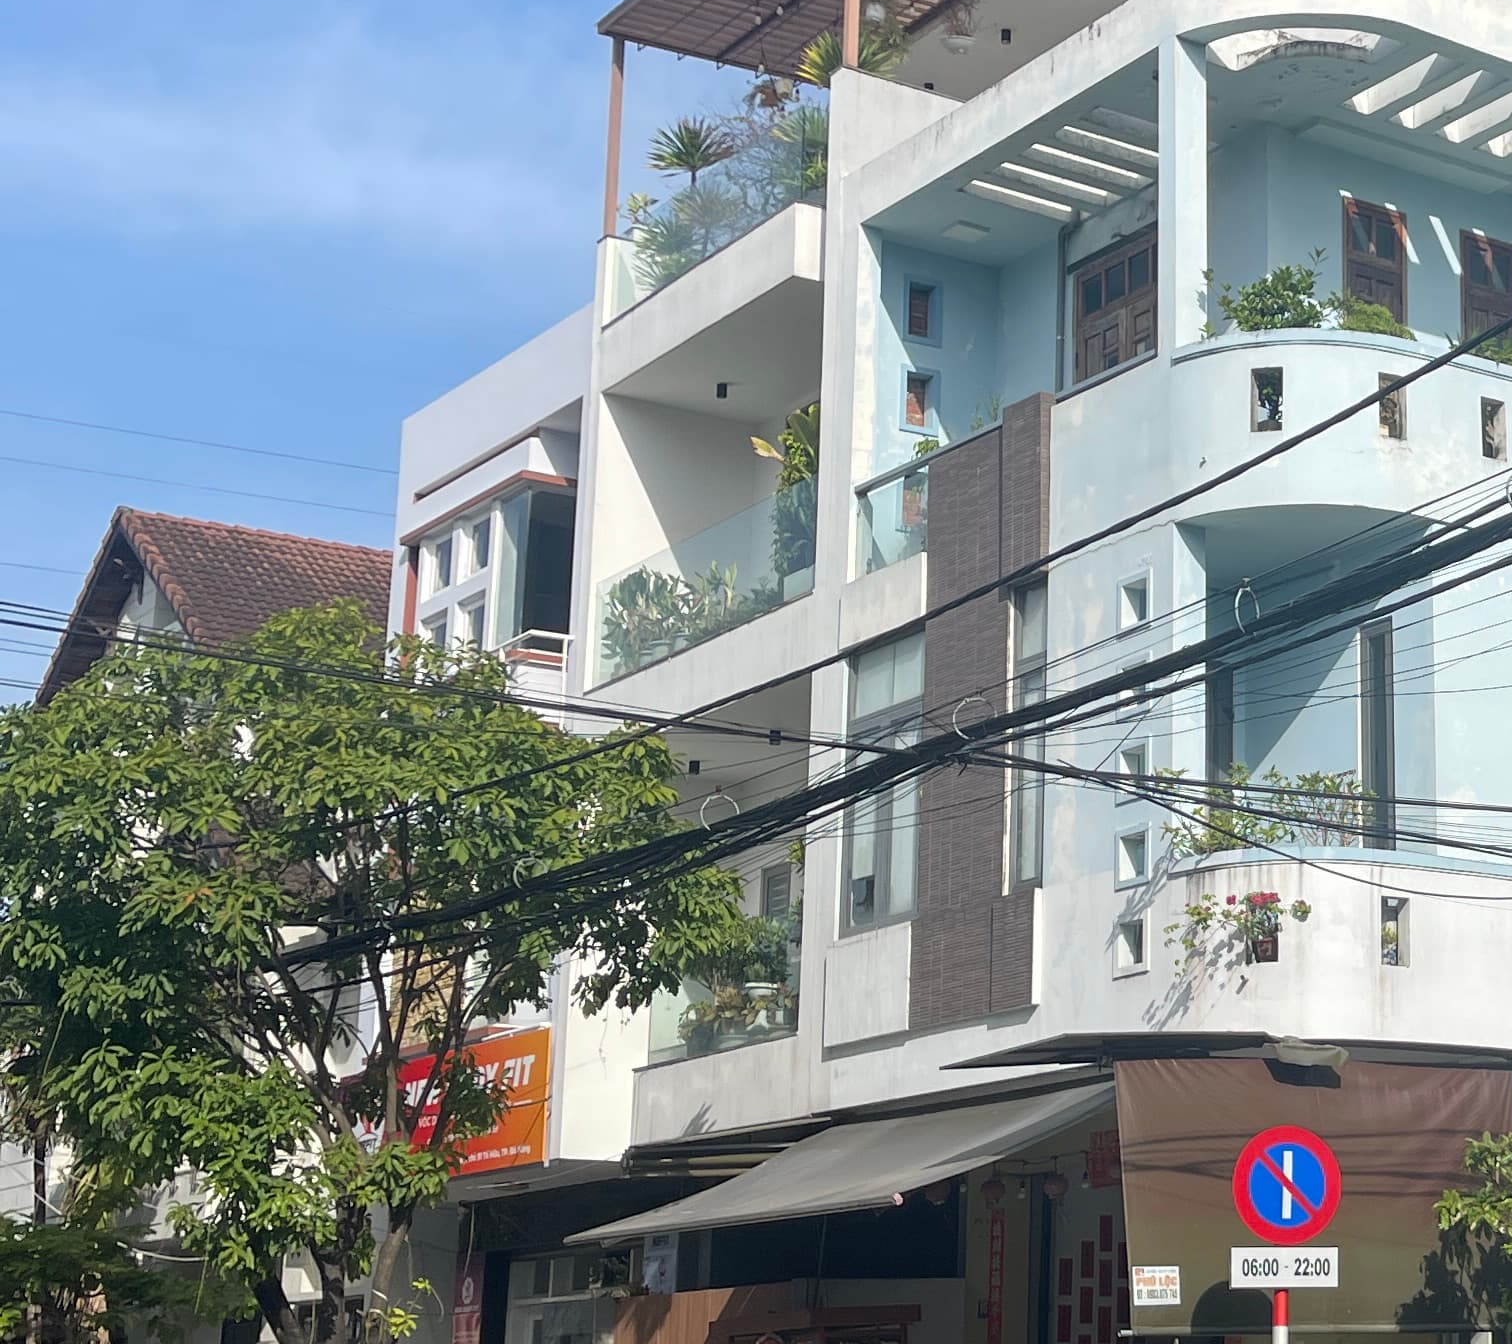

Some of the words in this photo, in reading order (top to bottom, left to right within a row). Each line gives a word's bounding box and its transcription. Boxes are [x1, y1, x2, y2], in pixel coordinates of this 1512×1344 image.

[503, 1054, 536, 1089] FIT
[1242, 1258, 1279, 1276] 06:00
[1294, 1258, 1330, 1276] 22:00
